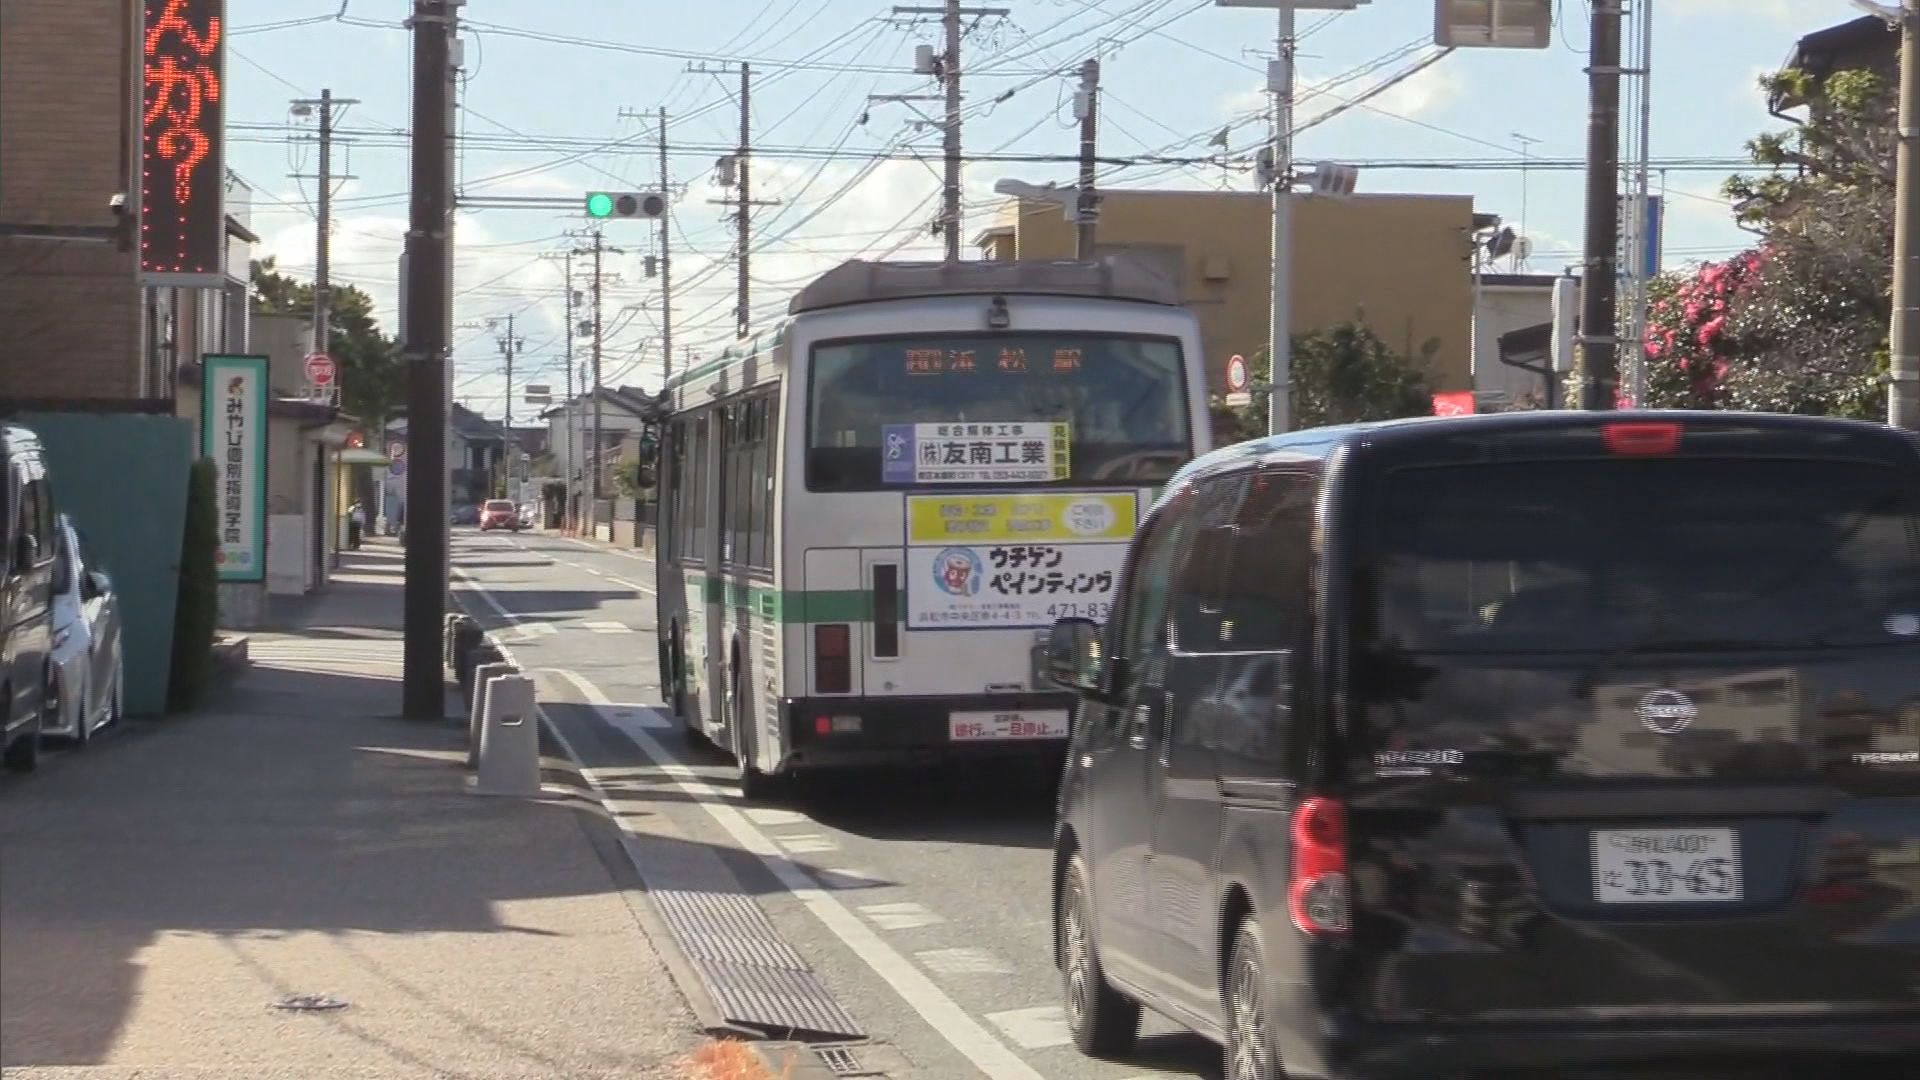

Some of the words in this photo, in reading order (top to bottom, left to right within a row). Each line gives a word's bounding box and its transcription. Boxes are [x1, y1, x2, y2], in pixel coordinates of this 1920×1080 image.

[989, 546, 1063, 568] ウチゲン
[989, 571, 1112, 595] ペインティング
[1624, 857, 1734, 896] 33-65
